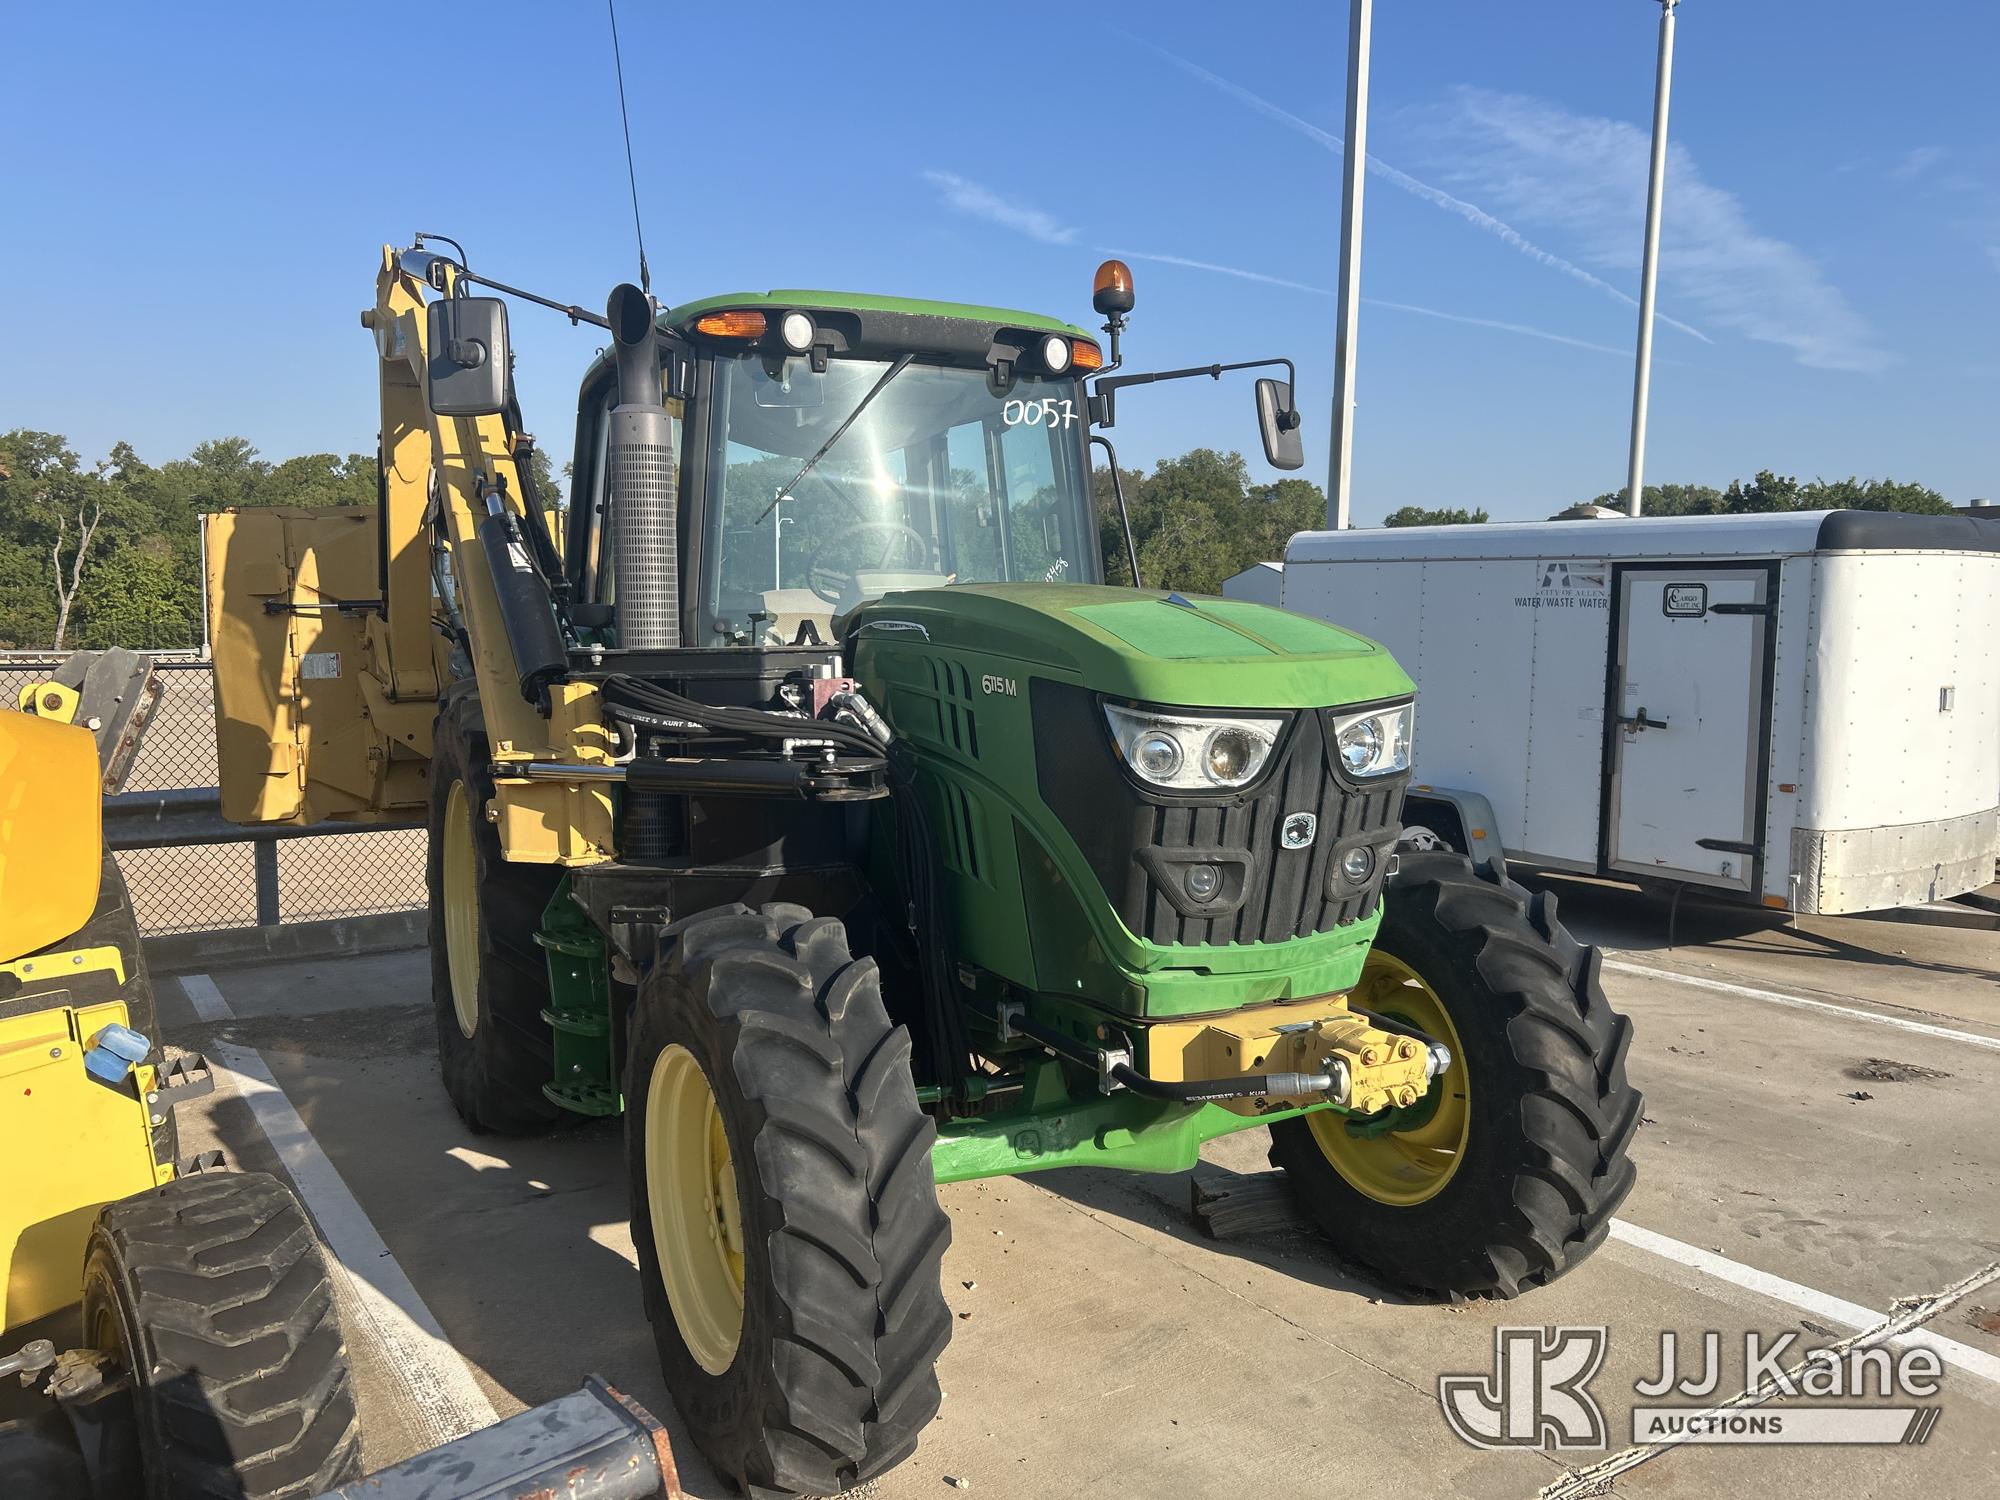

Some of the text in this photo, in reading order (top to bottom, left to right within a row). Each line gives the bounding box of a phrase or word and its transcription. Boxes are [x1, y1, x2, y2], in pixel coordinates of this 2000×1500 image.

[1002, 398, 1078, 429] 0057
[1514, 597, 1608, 609] WATER/WASTE WATER
[662, 720, 684, 728] KURT
